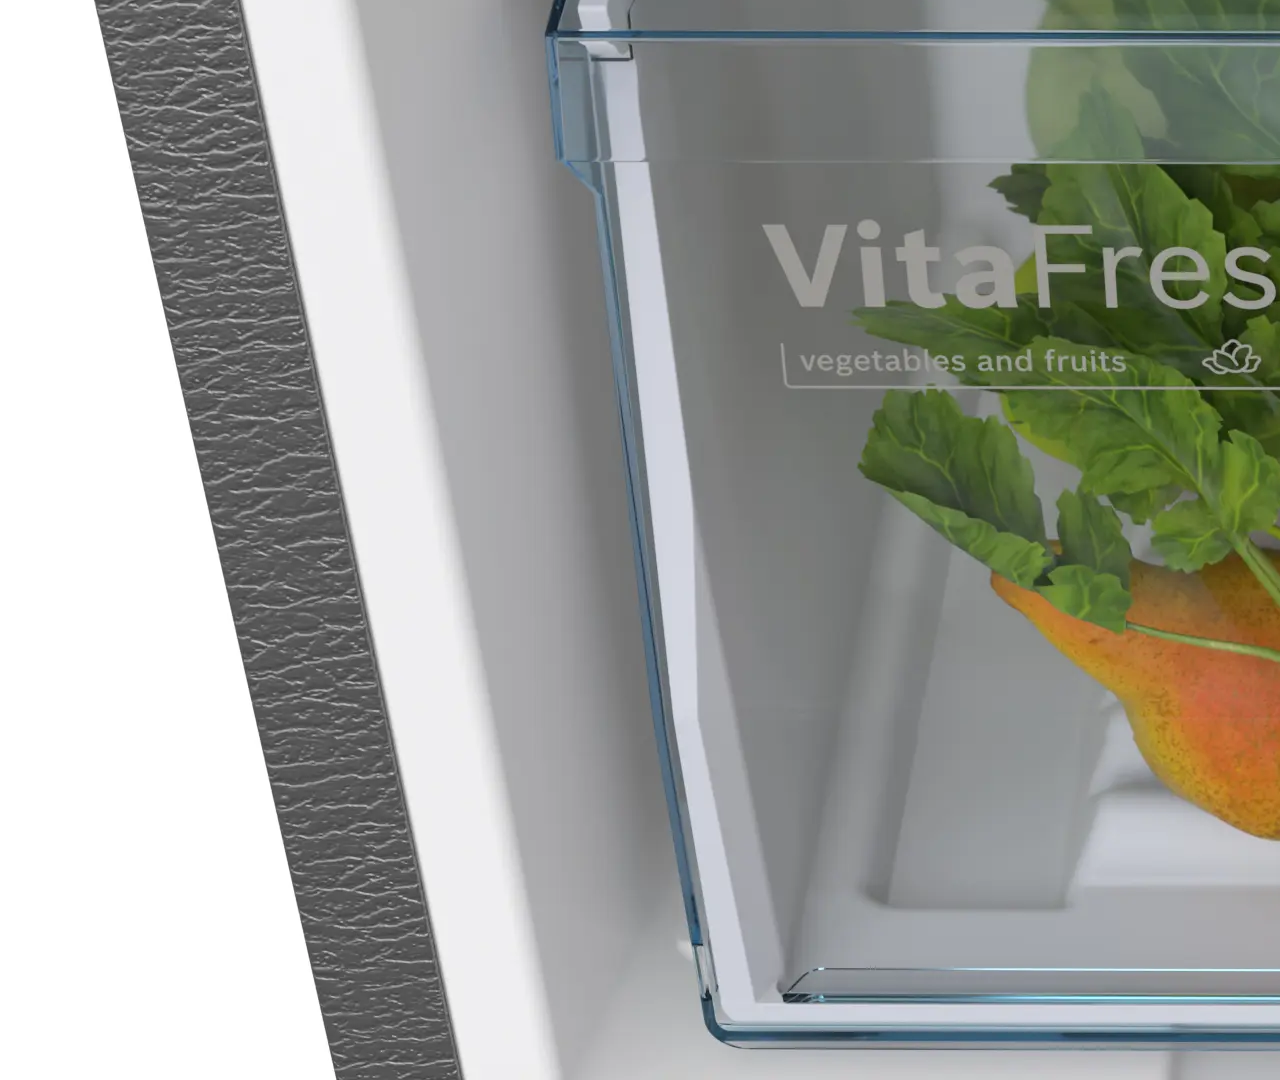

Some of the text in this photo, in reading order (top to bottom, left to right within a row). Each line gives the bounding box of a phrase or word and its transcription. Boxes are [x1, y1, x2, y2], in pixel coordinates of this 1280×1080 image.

[799, 347, 1127, 376] vegetables and fruits
